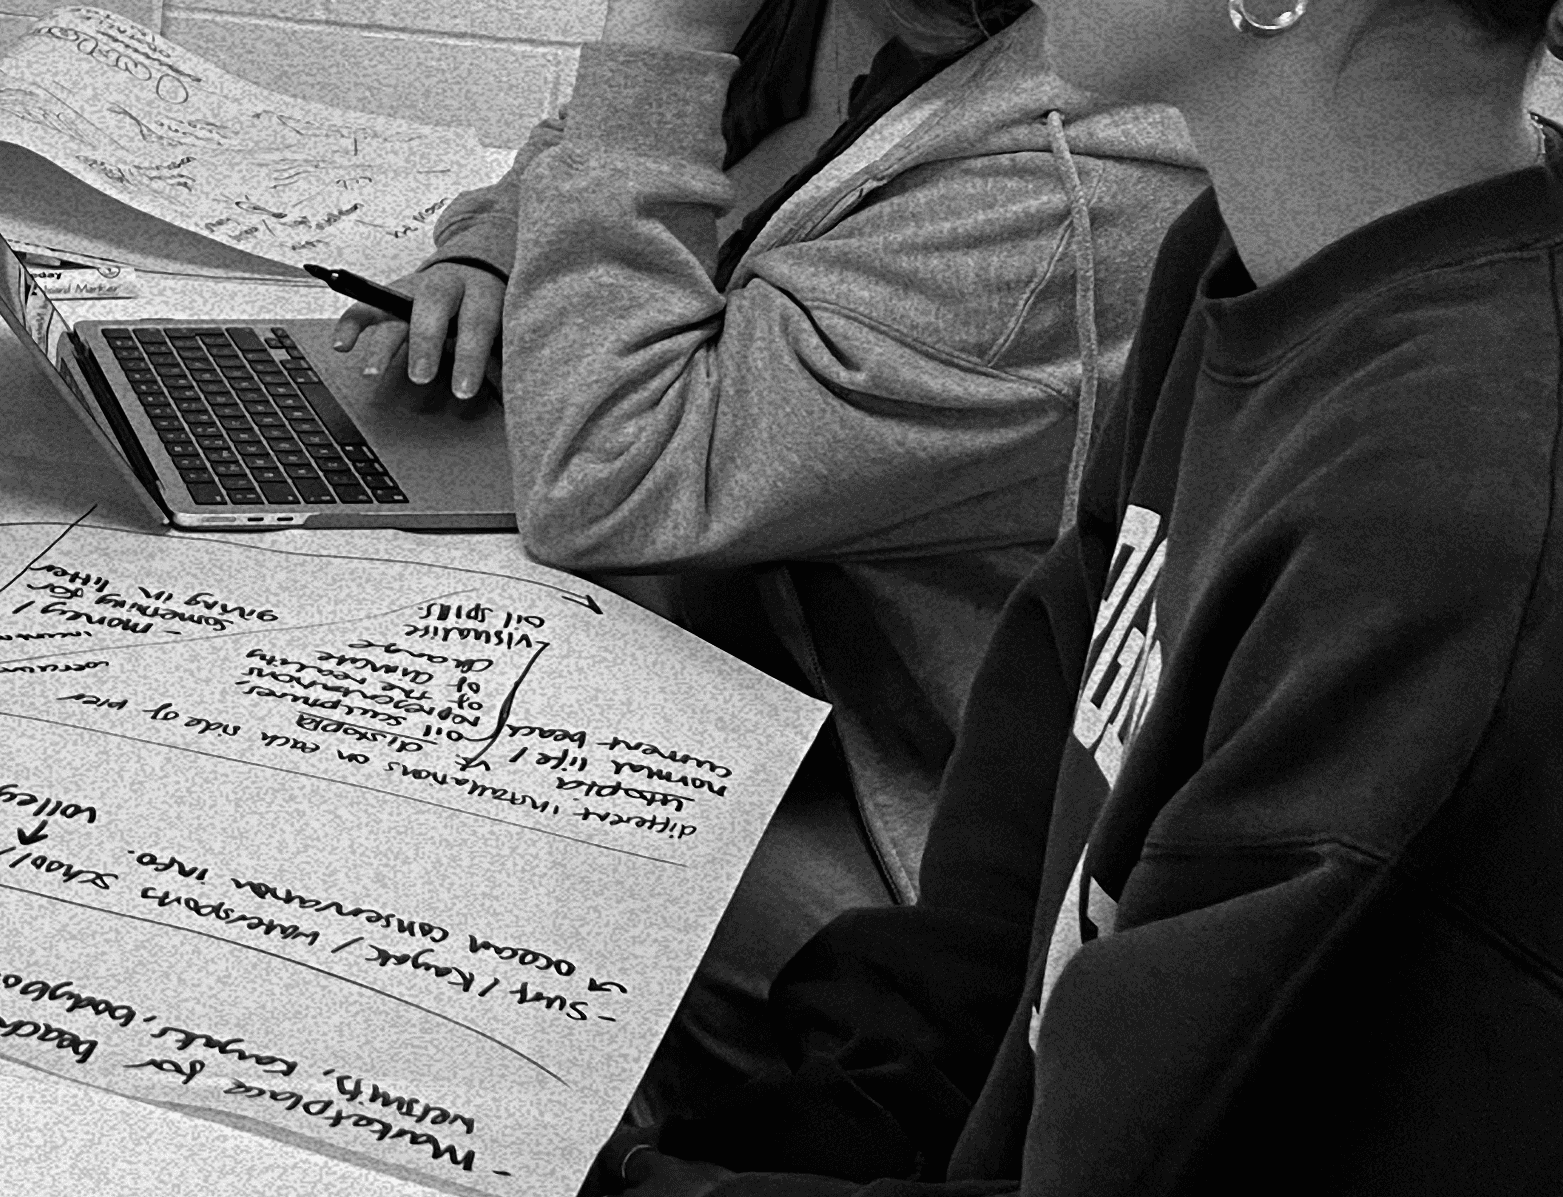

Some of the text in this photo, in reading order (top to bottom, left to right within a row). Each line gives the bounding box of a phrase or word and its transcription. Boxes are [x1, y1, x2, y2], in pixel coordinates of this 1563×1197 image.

[27, 563, 279, 623] giving in litter
[503, 611, 545, 631] oil
[401, 623, 533, 650] visualise
[244, 648, 367, 686] reality
[447, 676, 481, 695] of
[142, 703, 179, 722] of
[449, 694, 483, 712] of
[183, 715, 241, 737] side
[423, 724, 465, 743] oil
[260, 731, 321, 754] each
[506, 724, 732, 778] current beach
[337, 749, 370, 766] on
[535, 749, 588, 772] life
[383, 761, 559, 815] installations
[610, 760, 727, 797] normal
[572, 807, 697, 839] different
[140, 887, 320, 946] watersports
[230, 877, 449, 943] conservation
[123, 1060, 206, 1085] for
